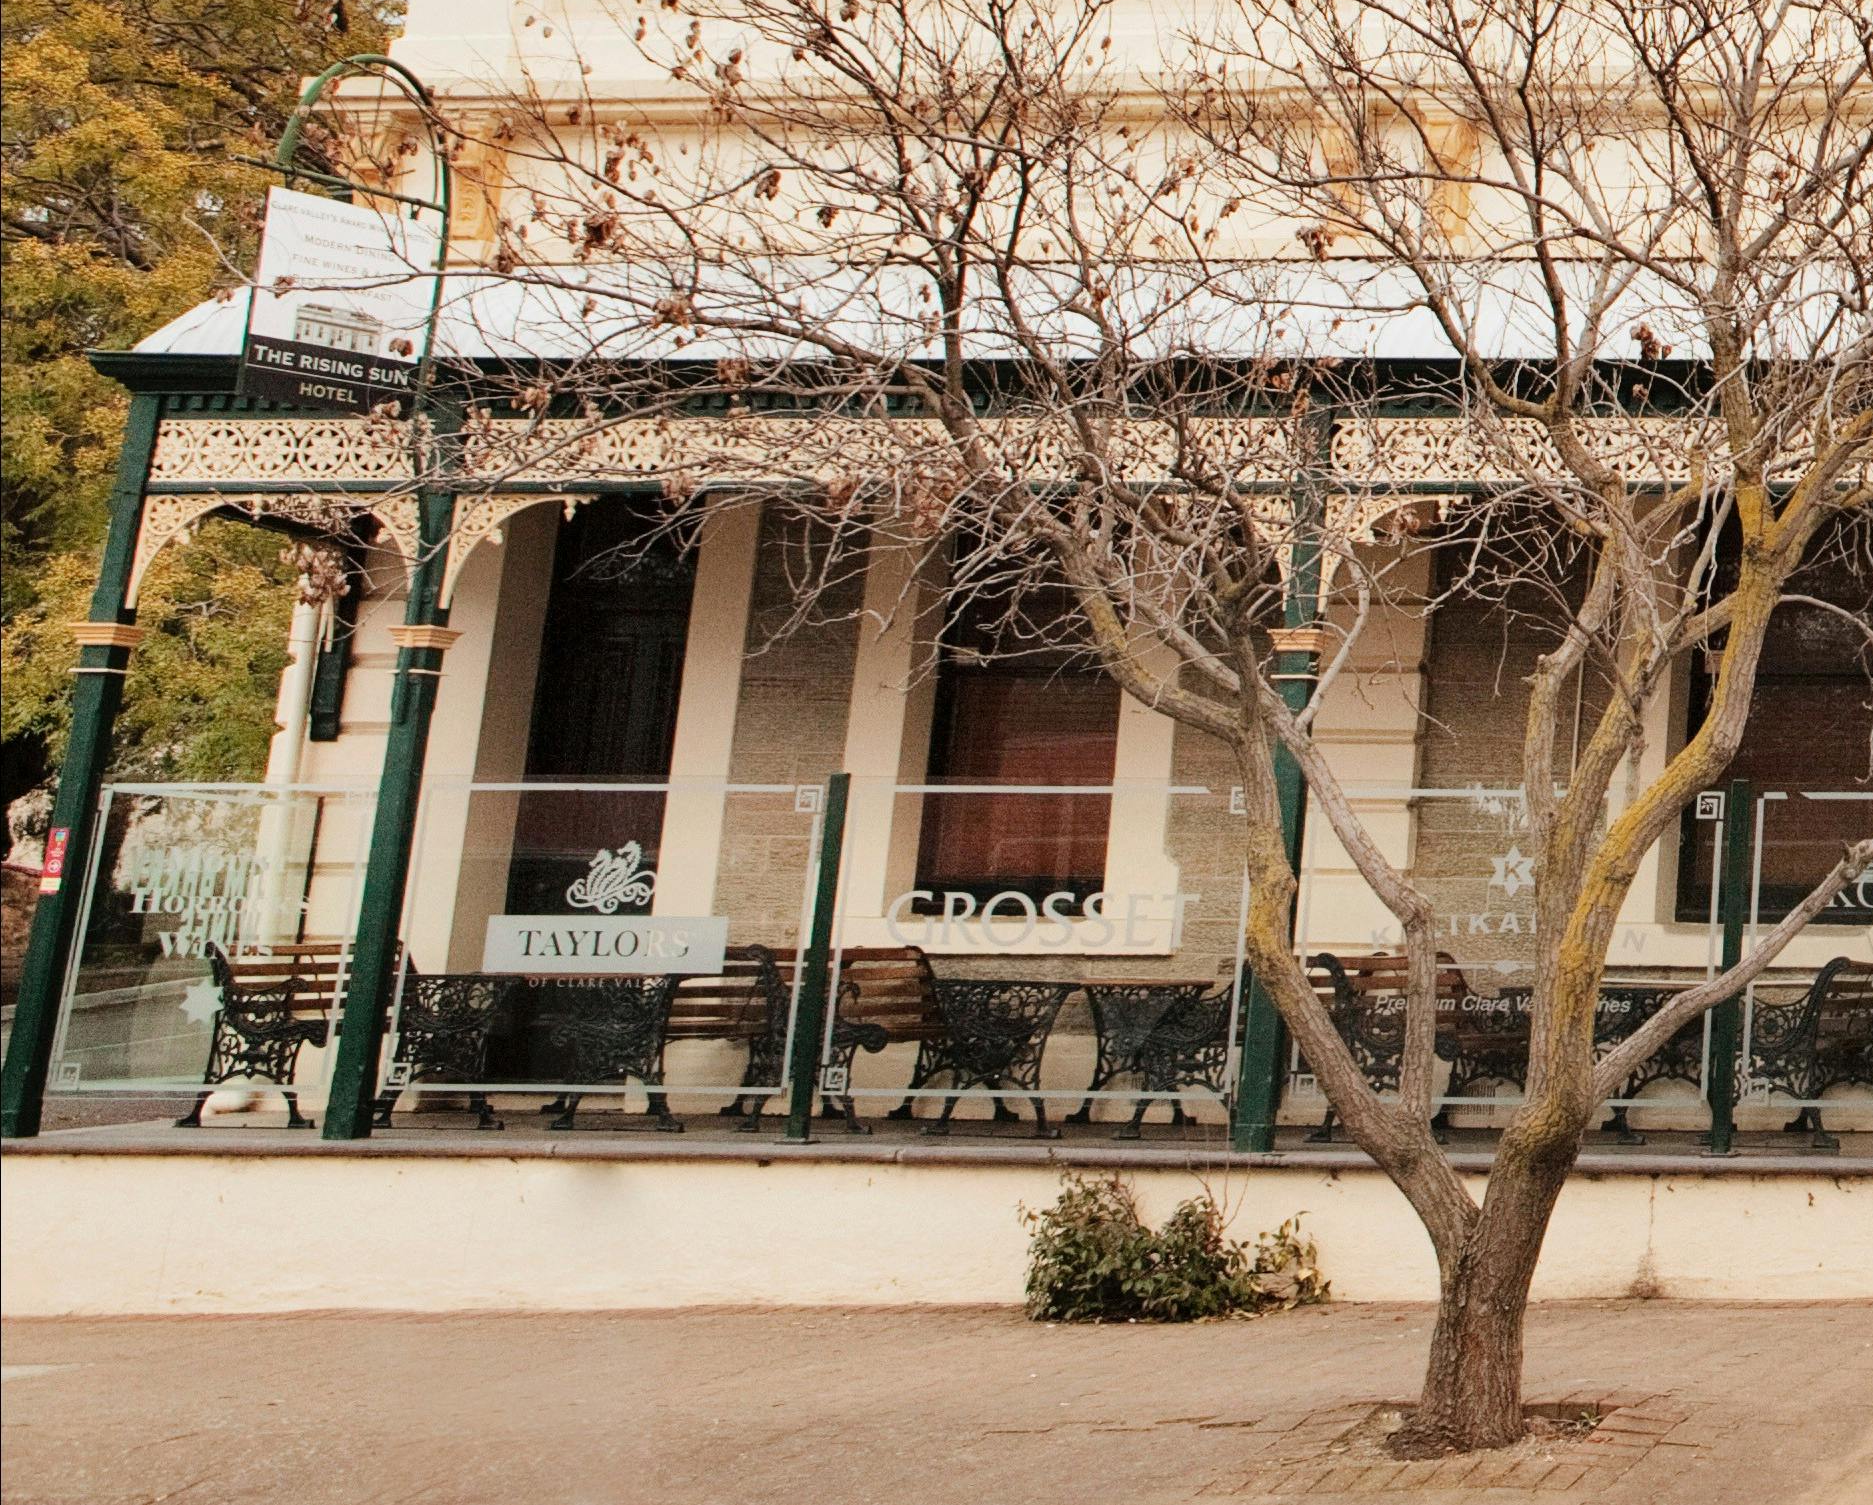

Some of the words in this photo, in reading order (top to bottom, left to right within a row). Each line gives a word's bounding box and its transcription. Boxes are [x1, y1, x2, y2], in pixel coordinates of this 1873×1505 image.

[304, 233, 353, 252] MODERN
[292, 252, 320, 268] FINE
[323, 261, 358, 274] WINES
[254, 344, 296, 366] THE
[300, 354, 364, 378] RISING
[368, 367, 409, 386] SUN
[299, 381, 359, 404] HOTEL
[887, 890, 1200, 949] GROSSET
[518, 929, 690, 958] TAYLORS
